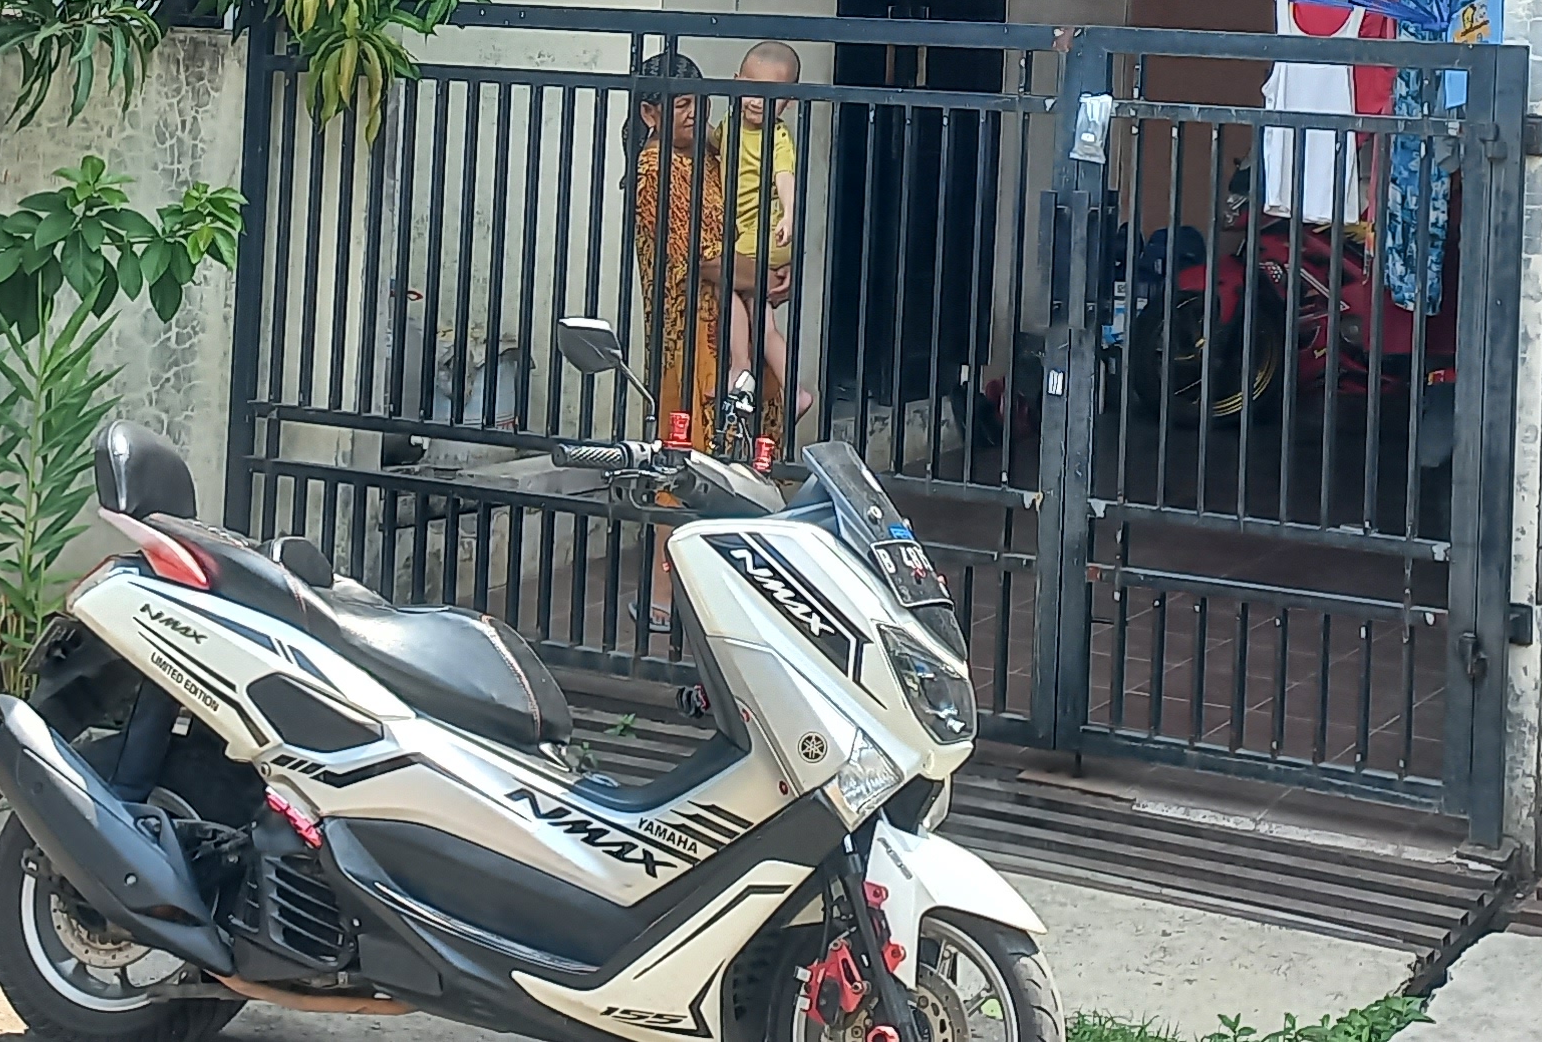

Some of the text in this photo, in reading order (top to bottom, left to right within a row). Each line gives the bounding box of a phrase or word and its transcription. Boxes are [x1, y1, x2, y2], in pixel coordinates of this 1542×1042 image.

[875, 547, 897, 575] B
[729, 548, 836, 637] NMAX
[139, 603, 208, 645] NMAX
[149, 651, 220, 712] LIMITED EDITION
[503, 787, 679, 879] NMAX
[636, 816, 699, 855] YAMAHA
[599, 1006, 689, 1025] 155
